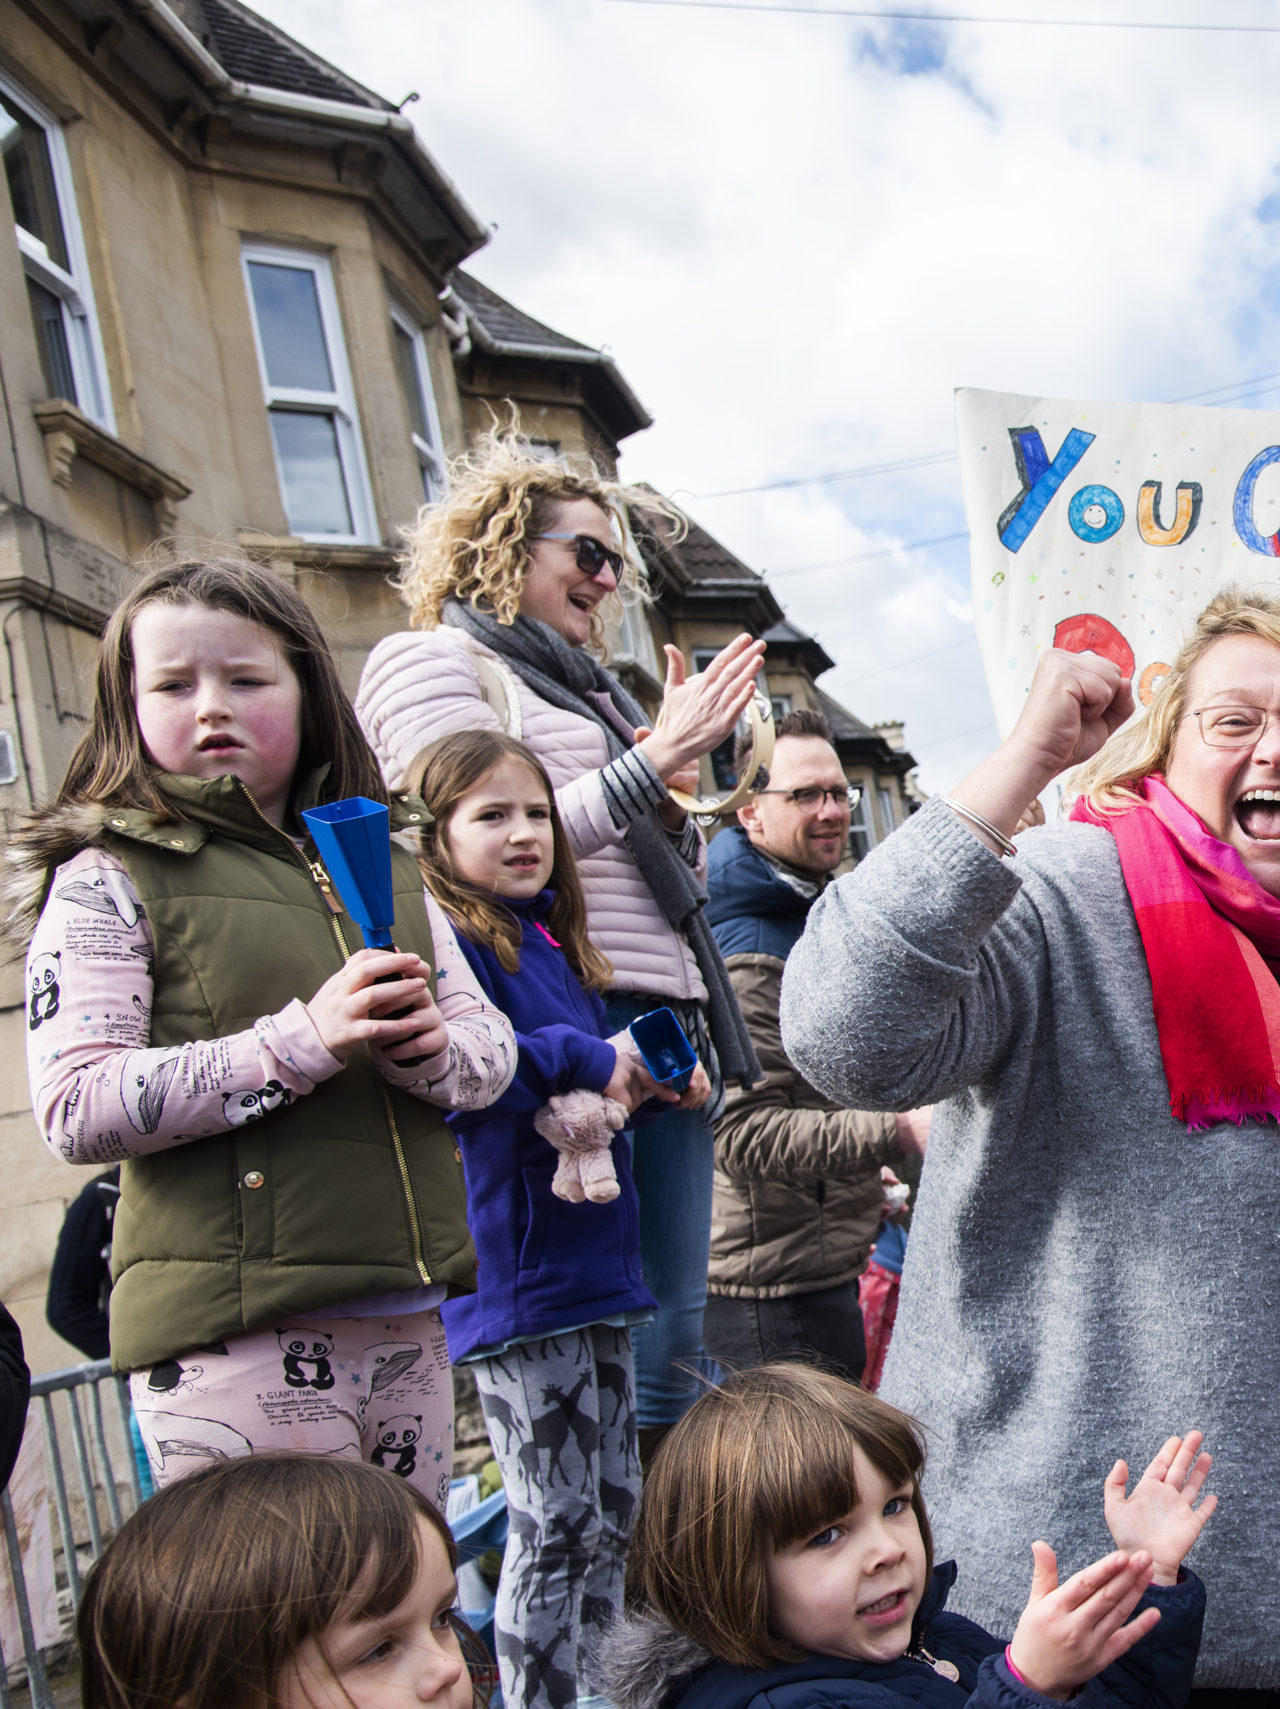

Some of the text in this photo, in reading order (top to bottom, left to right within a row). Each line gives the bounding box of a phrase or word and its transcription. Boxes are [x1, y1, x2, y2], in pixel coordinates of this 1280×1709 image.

[997, 425, 1203, 554] You
[72, 917, 91, 925] BLUE
[93, 918, 117, 927] WHALE
[116, 1013, 142, 1022] SNOW
[266, 1390, 295, 1400] GIANT
[297, 1389, 319, 1397] PANDA
